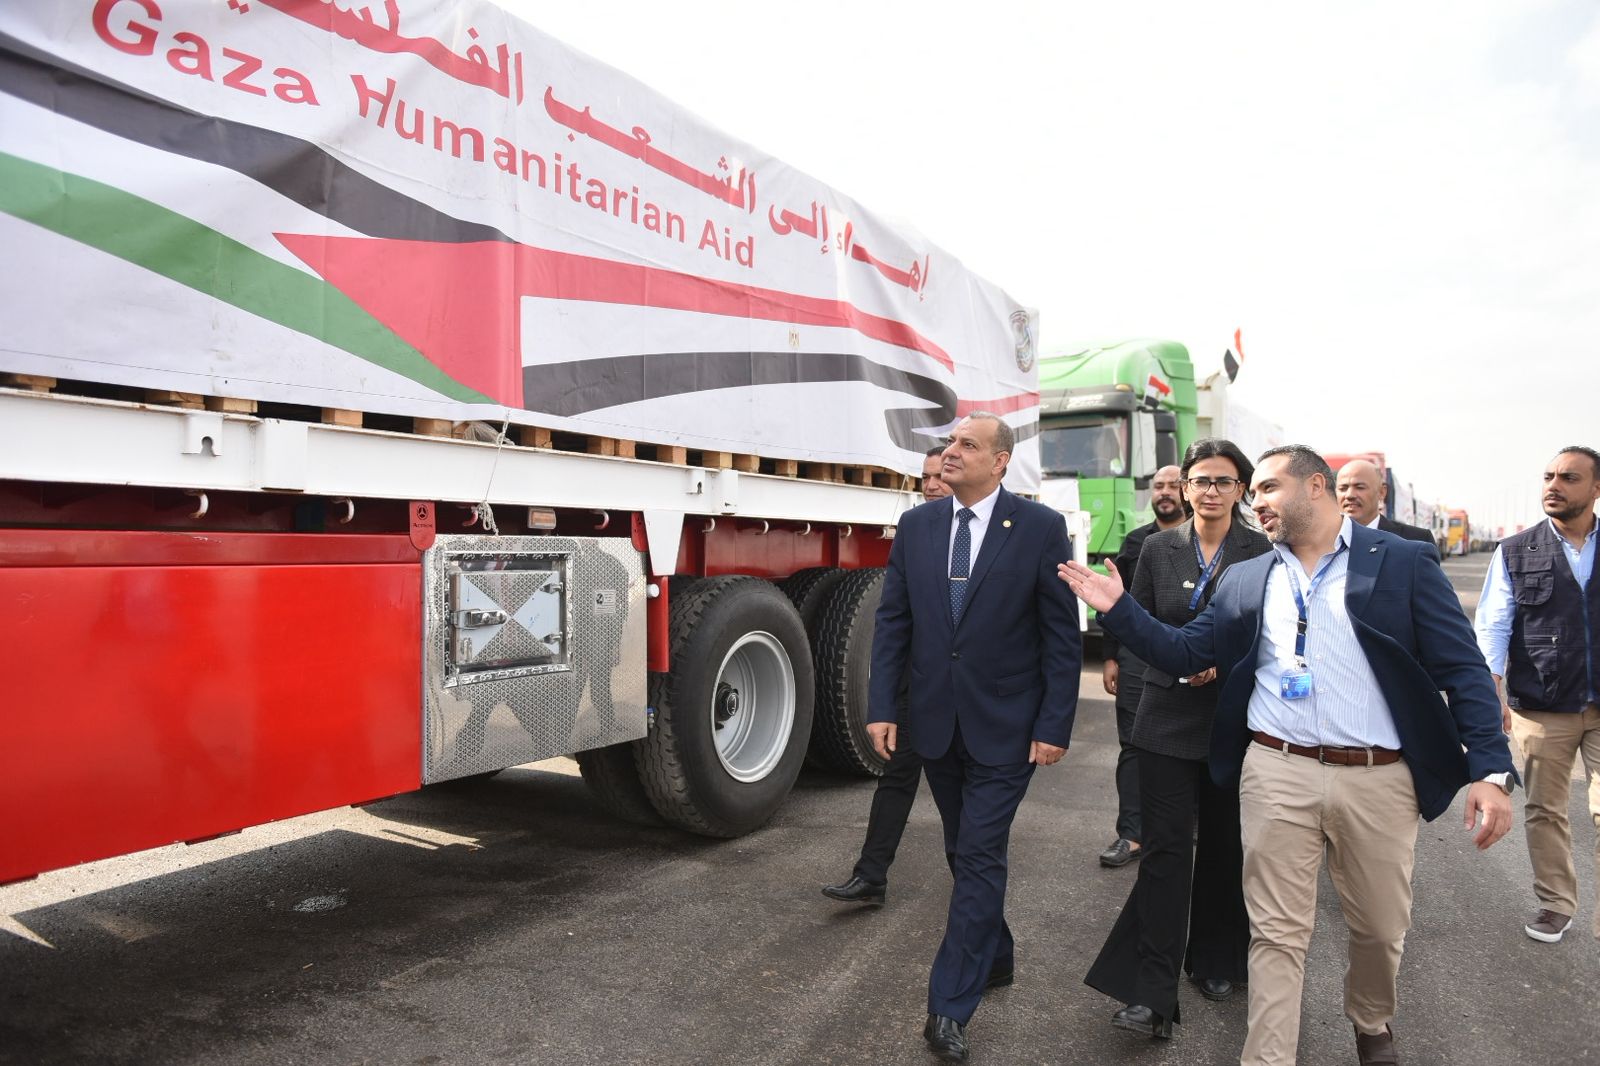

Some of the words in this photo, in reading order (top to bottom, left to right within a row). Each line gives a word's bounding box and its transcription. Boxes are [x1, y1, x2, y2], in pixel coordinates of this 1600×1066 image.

[91, 0, 320, 107] Gaza
[350, 74, 686, 241] Humanitarian
[698, 219, 755, 269] Aid
[544, 86, 757, 213] الشعب
[768, 200, 830, 256] إلى
